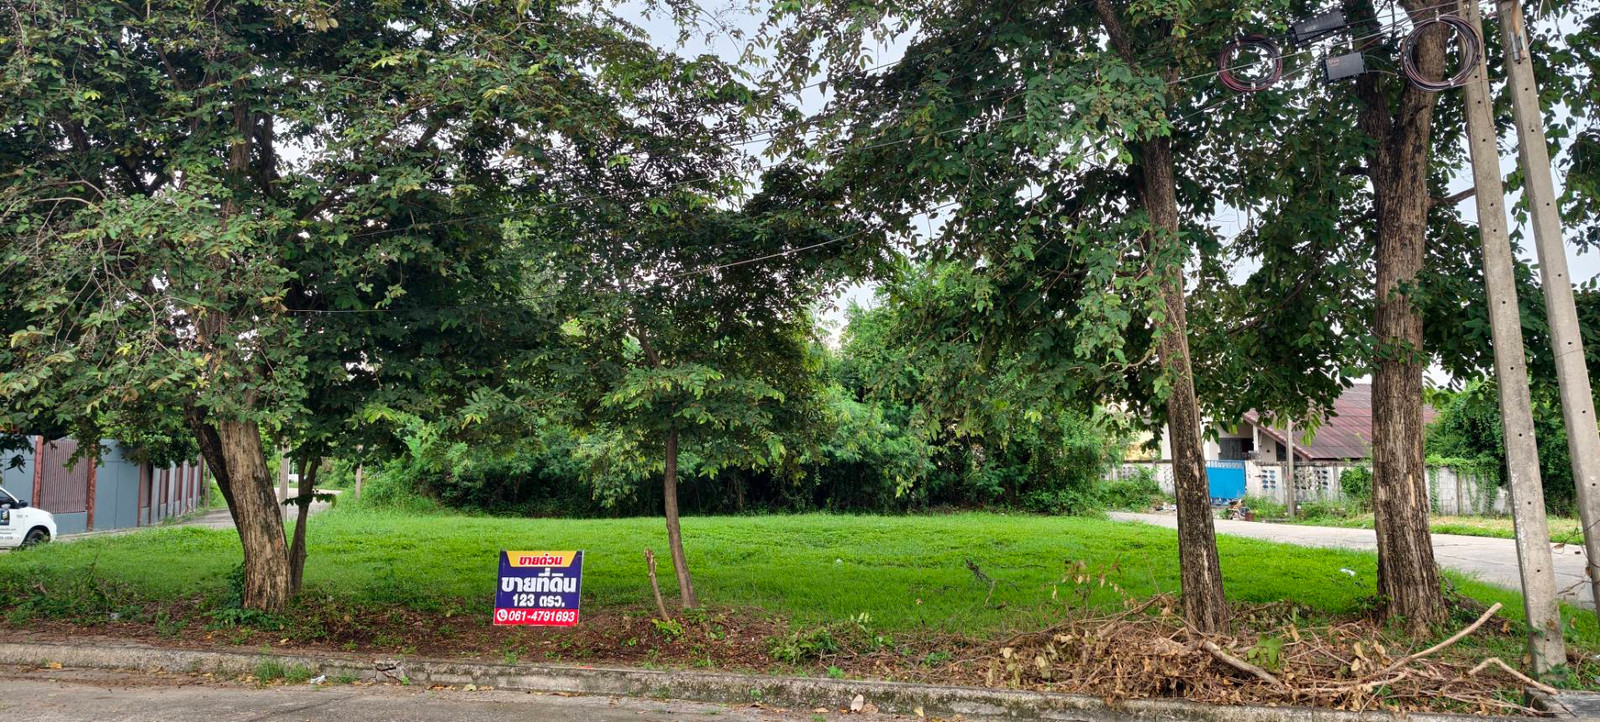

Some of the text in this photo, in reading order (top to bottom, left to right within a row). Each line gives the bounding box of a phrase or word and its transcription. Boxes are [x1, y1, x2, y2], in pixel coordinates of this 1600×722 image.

[519, 553, 563, 566] ขายด่วน
[501, 567, 577, 593] ขายที่ดิน
[513, 593, 566, 608] 123 ตรว.
[508, 610, 576, 622] 061-4791693
